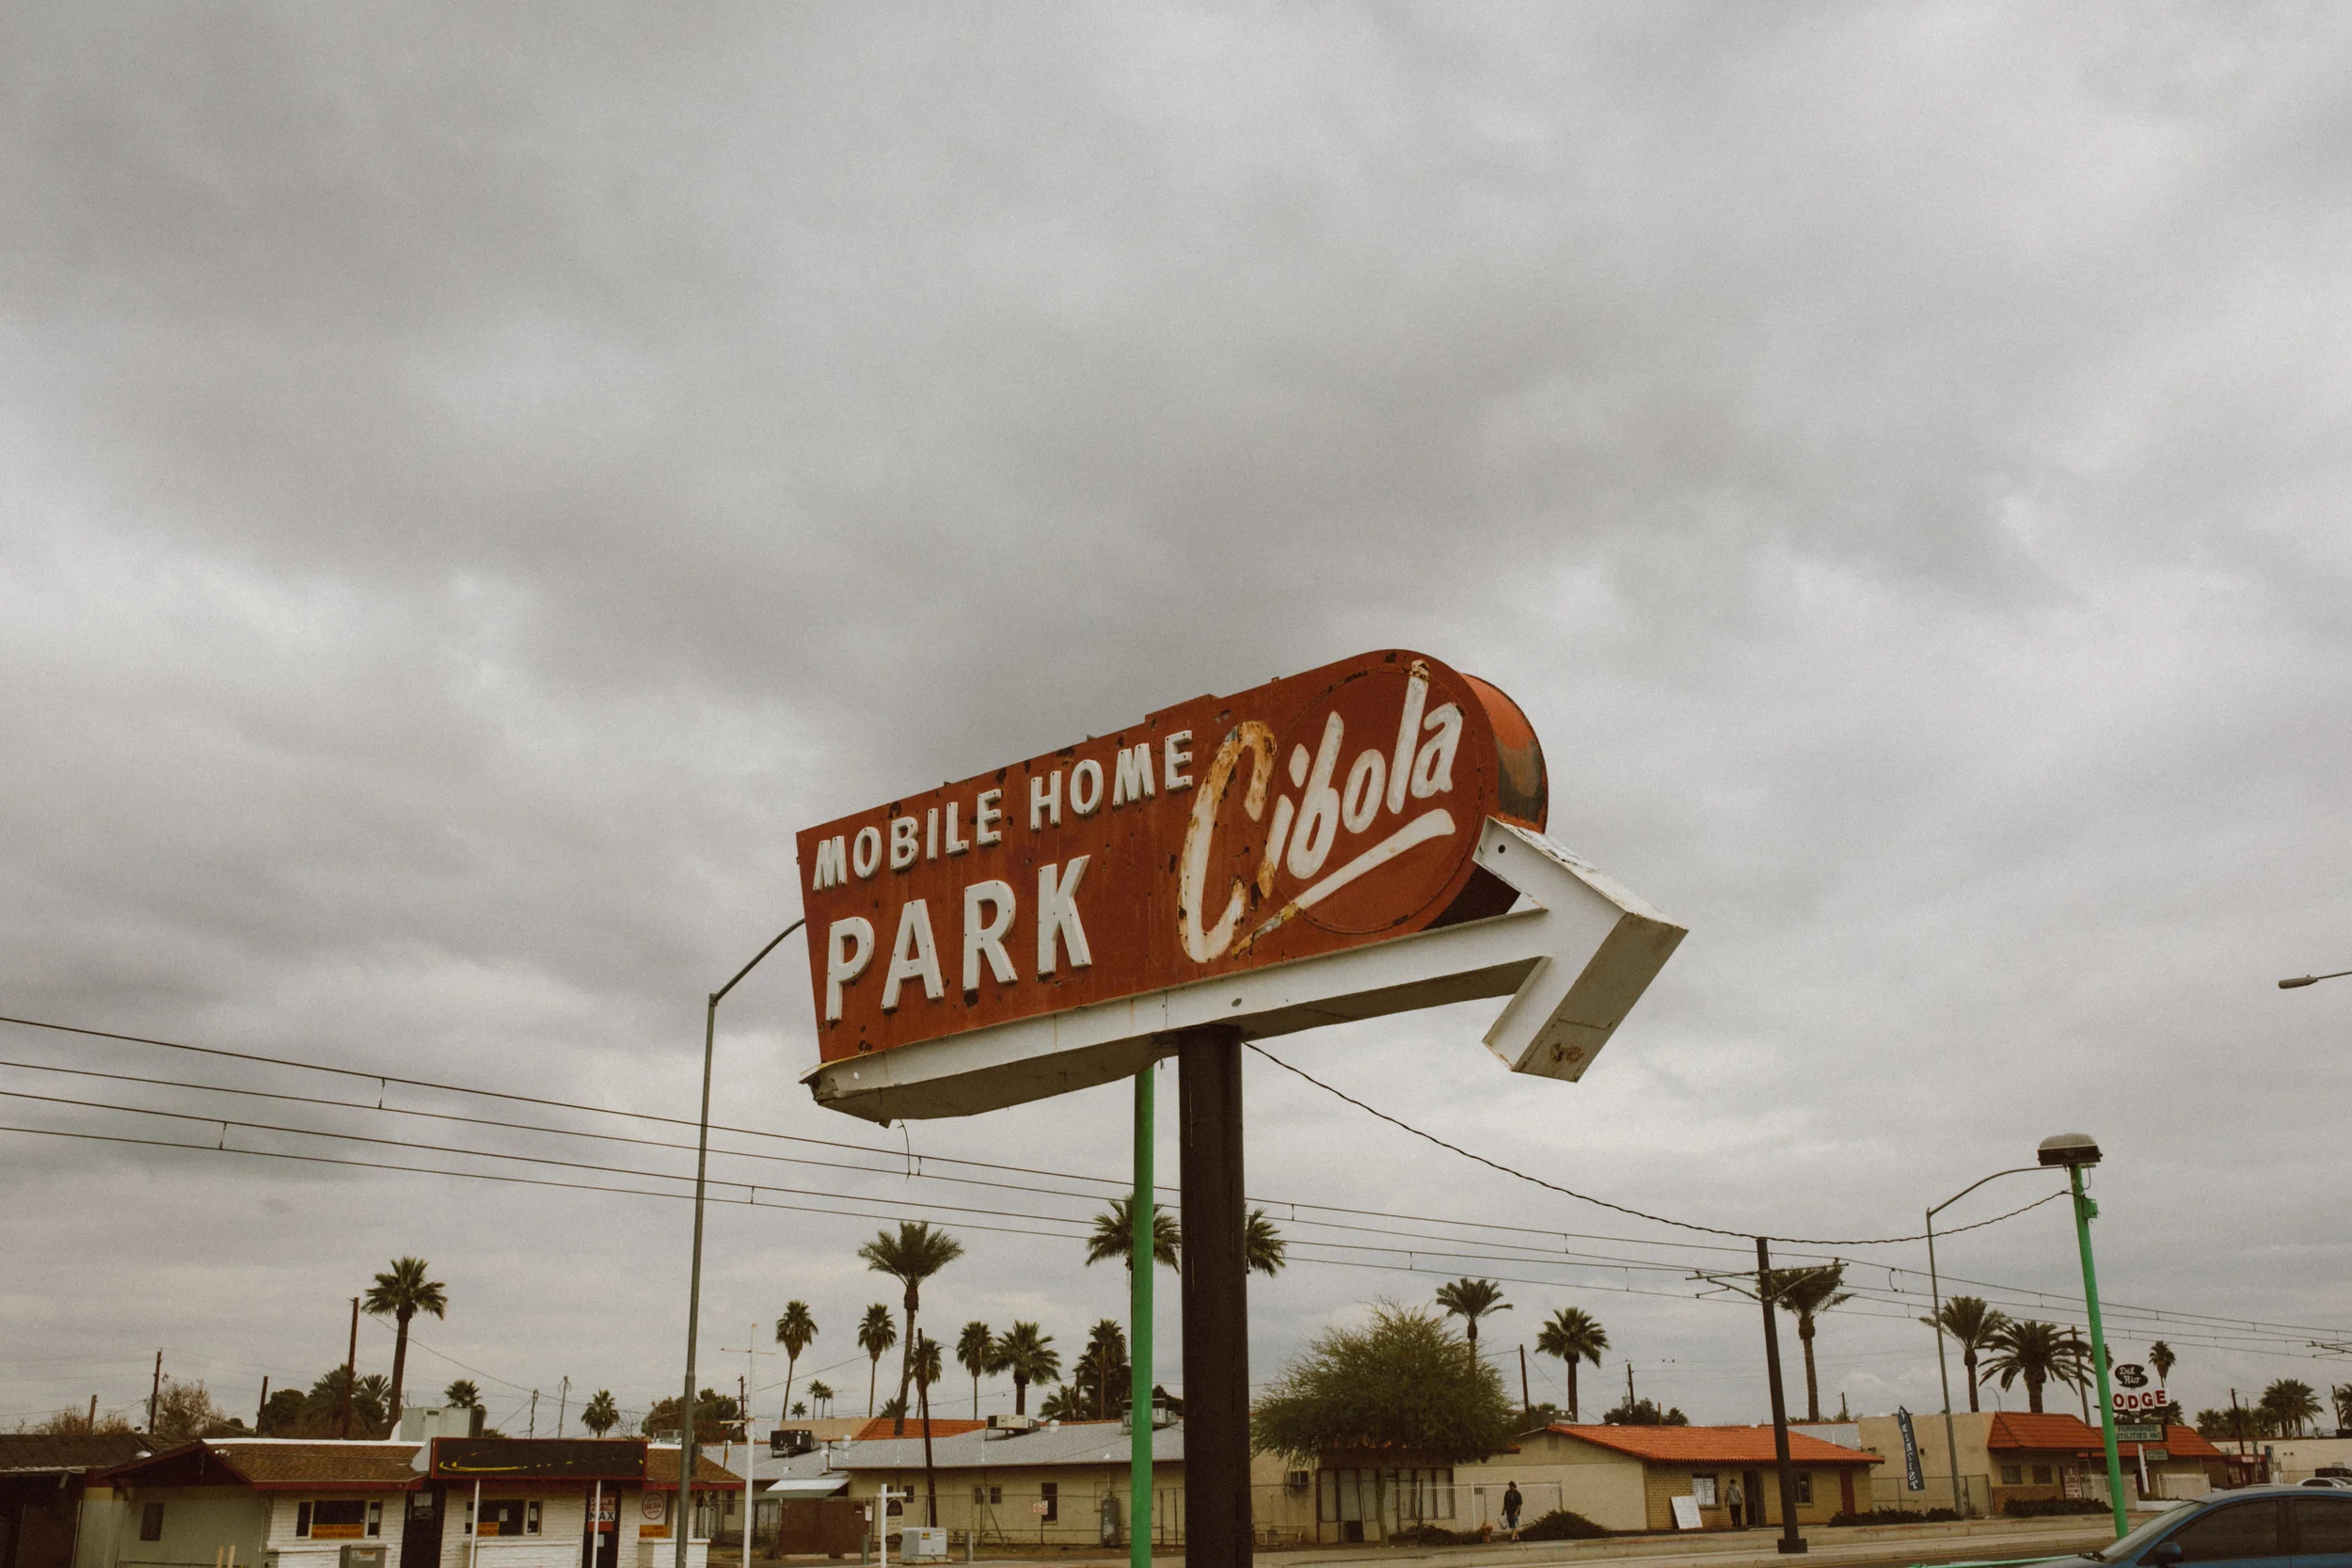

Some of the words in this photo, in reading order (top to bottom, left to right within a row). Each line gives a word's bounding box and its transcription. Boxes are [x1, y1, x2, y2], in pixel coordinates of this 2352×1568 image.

[812, 788, 1002, 892] MOBILE
[1029, 729, 1193, 832] HOME
[1177, 658, 1464, 963] Cibola
[825, 854, 1093, 1022] PARK
[2119, 1366, 2136, 1375] Del
[2122, 1375, 2141, 1385] Rio
[2112, 1389, 2168, 1409] ODGE
[2117, 1424, 2157, 1433] FURNISHED
